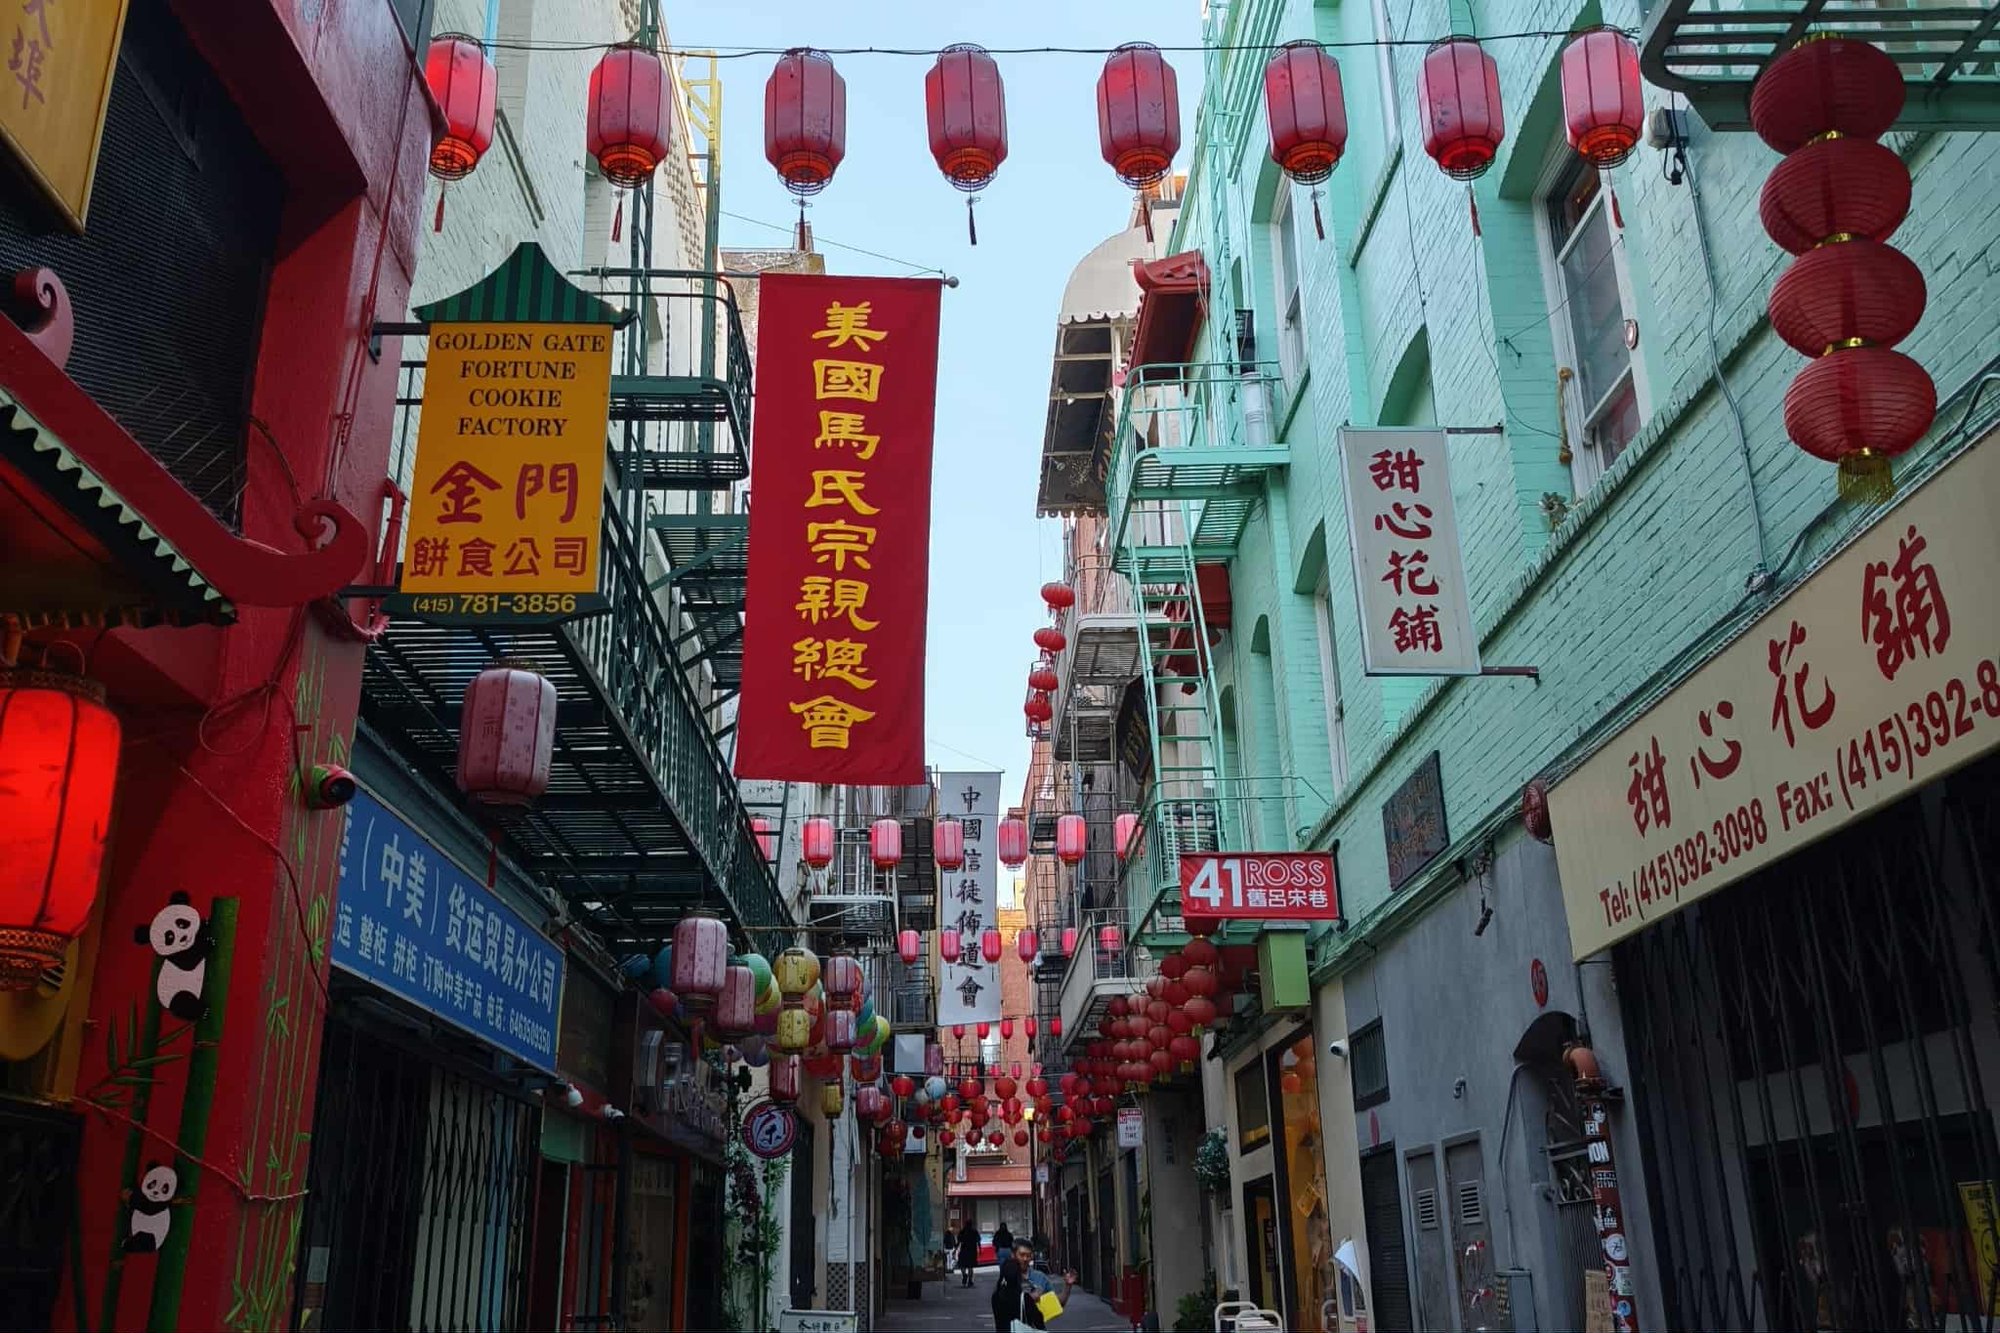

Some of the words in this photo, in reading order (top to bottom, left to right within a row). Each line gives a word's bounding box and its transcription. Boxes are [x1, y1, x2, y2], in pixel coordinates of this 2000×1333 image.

[435, 333, 532, 351] GOLDEN
[543, 334, 605, 352] GATE
[460, 360, 576, 380] FORTUNE
[469, 389, 562, 408] COOKIE
[457, 417, 568, 437] FACTORY
[430, 460, 579, 524] 金門
[790, 300, 887, 749] 美國馬氏宗親總會
[410, 537, 588, 577] 餅食公司
[1368, 448, 1443, 653] 甜心花舖
[413, 597, 454, 613] (415)
[460, 594, 576, 613] 781-3856
[1599, 880, 1634, 928] Tel:
[1633, 797, 1768, 921] (415)392-3098
[1775, 771, 1834, 832] Fax:
[955, 785, 984, 1009] 中國信徒佈道會
[1189, 859, 1243, 907] 41
[1246, 859, 1326, 887] ROSS
[1247, 889, 1329, 908] 舊呂宋巷
[333, 901, 353, 949] 运
[340, 805, 556, 1013] （中美）货运贸易分公司
